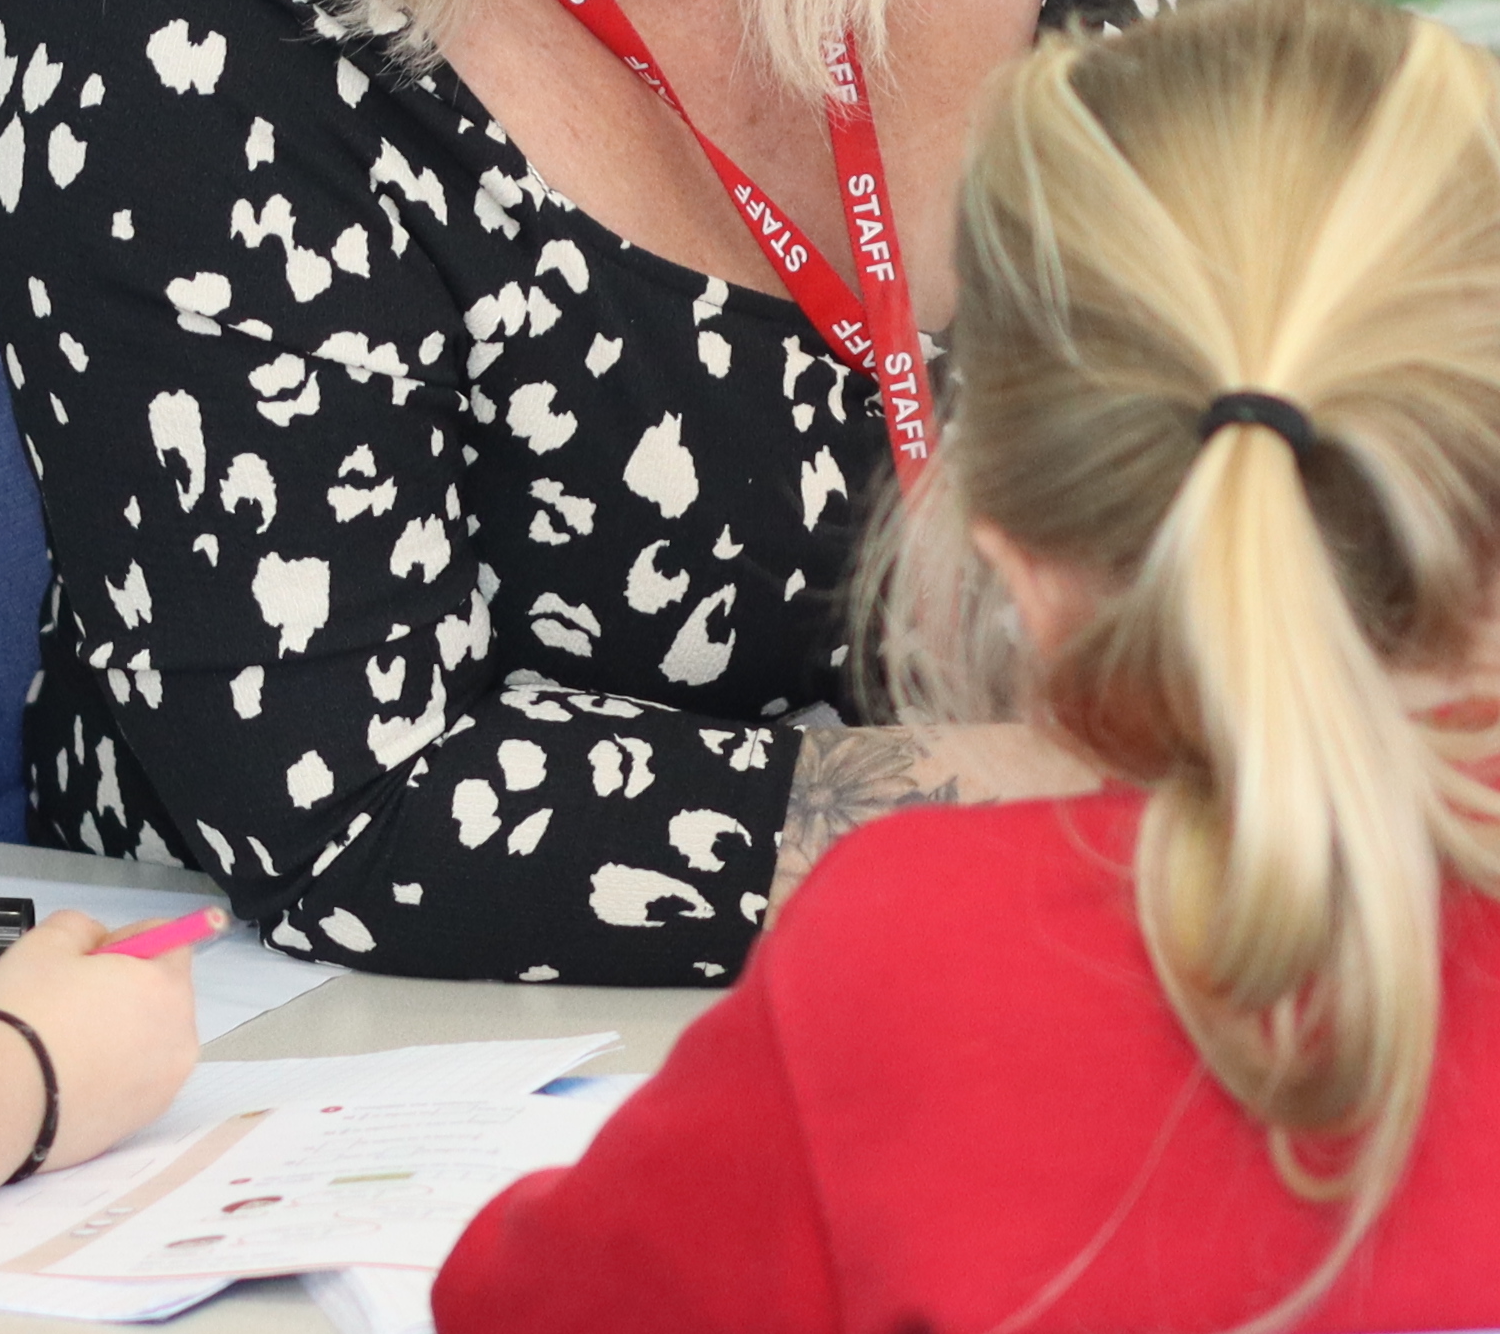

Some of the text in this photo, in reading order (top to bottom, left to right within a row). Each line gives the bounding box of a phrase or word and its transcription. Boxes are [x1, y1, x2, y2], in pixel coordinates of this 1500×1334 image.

[822, 39, 858, 103] AFF
[734, 183, 808, 273] STAFF
[848, 173, 895, 282] STAFF
[884, 351, 928, 460] STAFF
